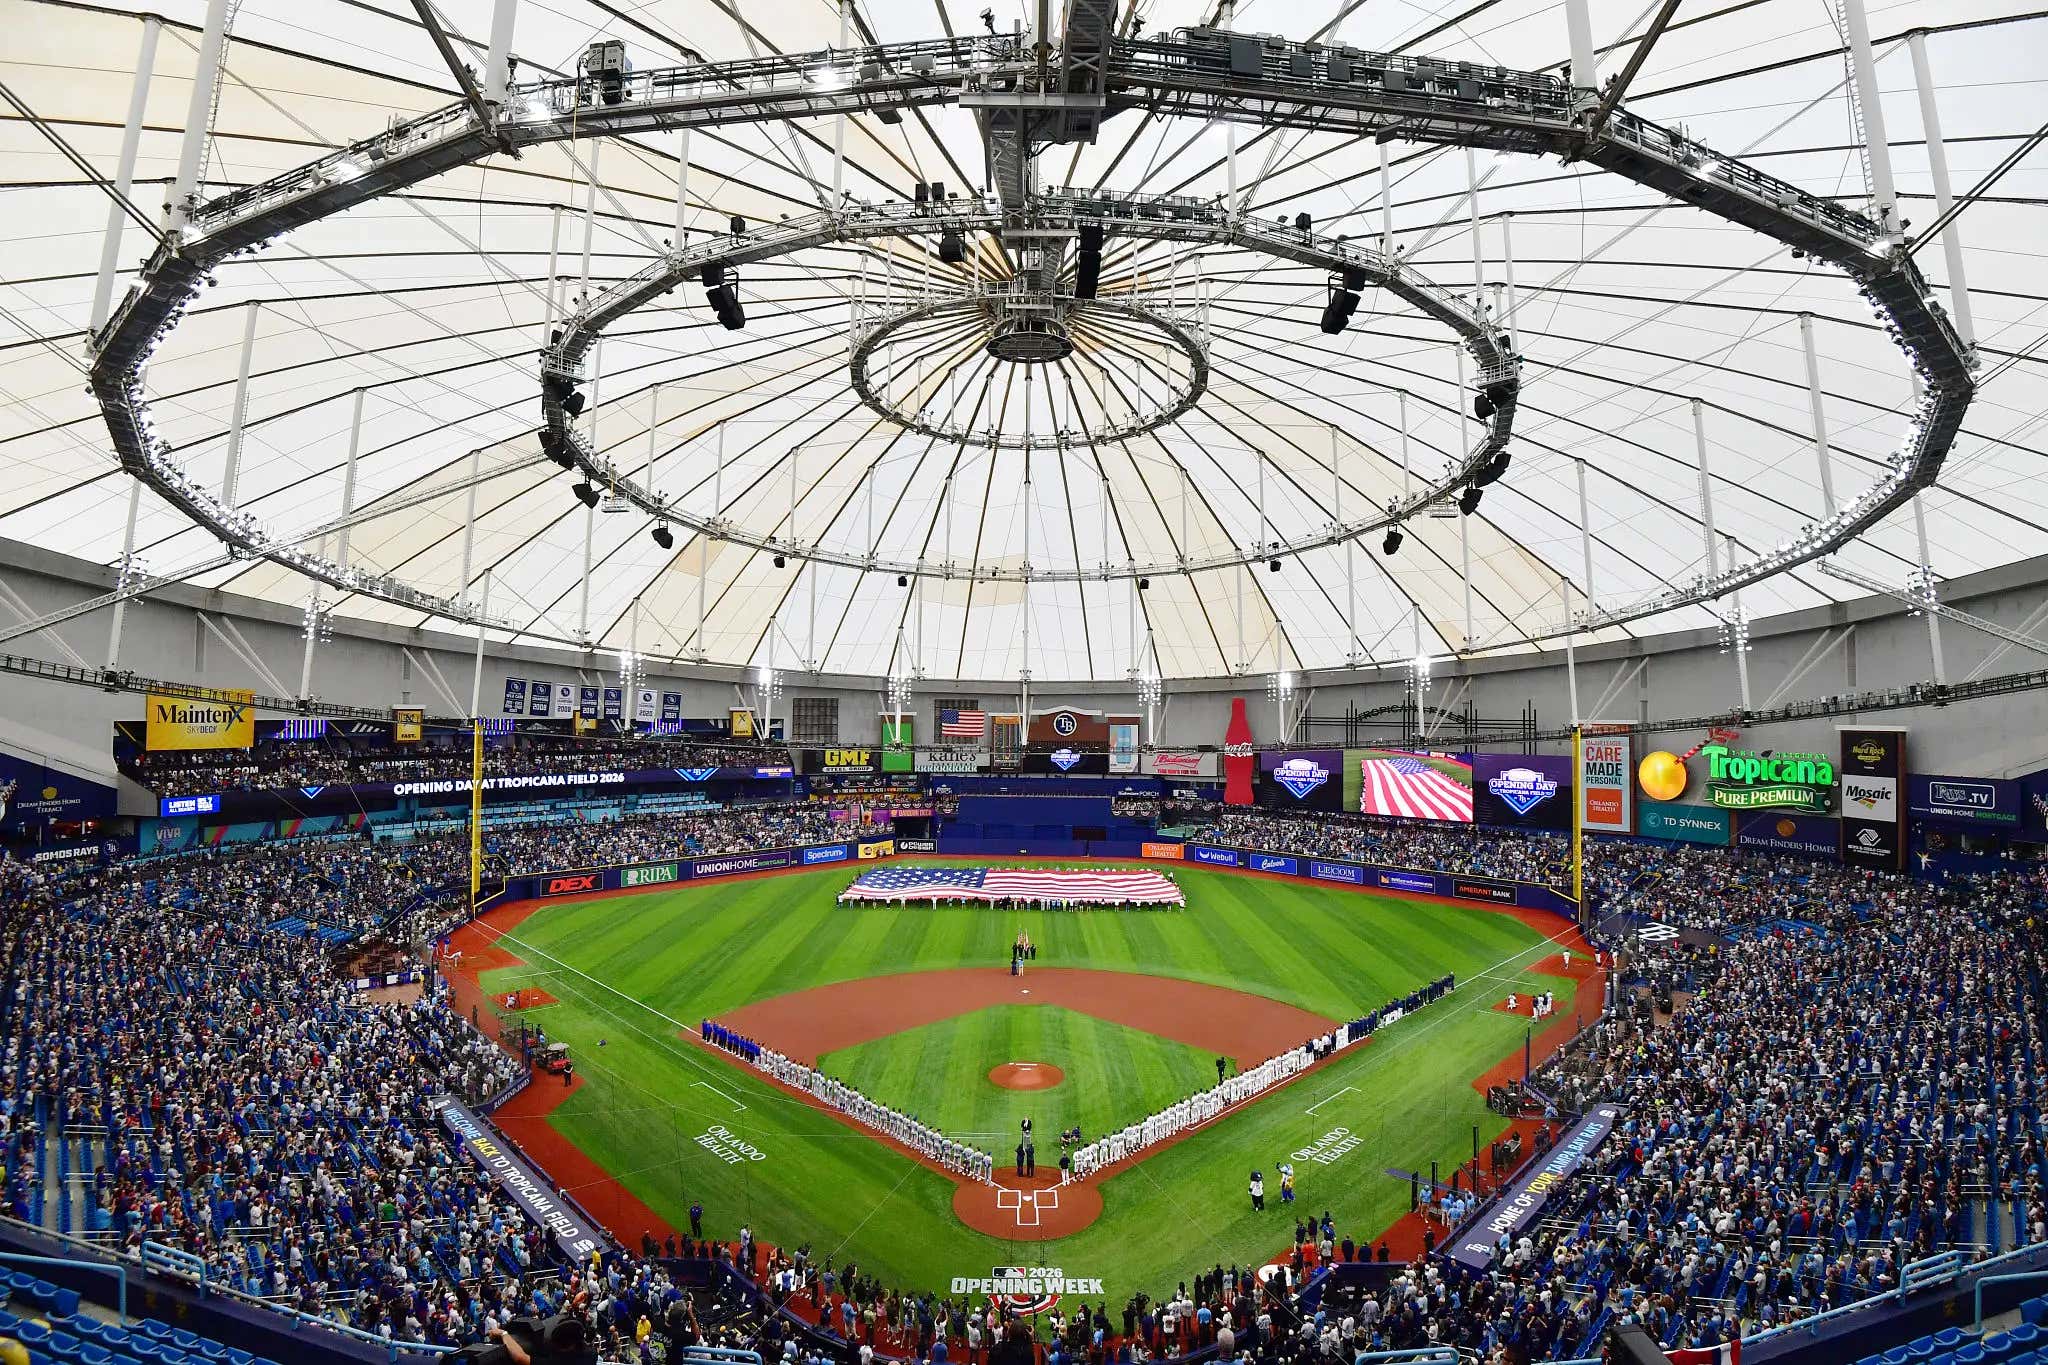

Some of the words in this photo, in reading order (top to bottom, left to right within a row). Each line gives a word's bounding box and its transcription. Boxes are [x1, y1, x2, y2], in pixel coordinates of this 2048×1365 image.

[156, 704, 247, 732] MaintenX
[1058, 718, 1073, 732] TB
[1586, 747, 1622, 762] CARE
[1586, 762, 1622, 776] MADE
[1702, 745, 1833, 786] Tropicana
[1275, 770, 1311, 778] OPENING
[1586, 777, 1623, 785] PERSONAL
[394, 782, 453, 795] OPENING
[481, 778, 498, 789] AT
[497, 775, 565, 788] TROPICANA
[567, 773, 598, 784] FIELD
[600, 772, 625, 783] 2026
[1491, 780, 1533, 790] OPENING
[1535, 782, 1555, 791] DAY
[1714, 789, 1748, 805] PURE
[1751, 787, 1814, 805] PREMIUM
[1846, 785, 1892, 800] Mosaic
[1930, 807, 1953, 817] UNION
[1953, 809, 1974, 818] HOME
[1975, 811, 2017, 822] MORTGAGE
[1664, 817, 1677, 826] TD
[1679, 818, 1721, 832] SYNNEX
[156, 827, 182, 841] VIVA
[1740, 835, 1768, 847] DREAM
[1770, 838, 1802, 851] FINDERS
[1805, 843, 1836, 854] HOMES
[34, 850, 73, 862] SOMOS
[73, 845, 100, 858] RAYS
[807, 849, 844, 862] Spectrum
[1151, 850, 1176, 858] HEALTH
[1210, 851, 1234, 863] Webull
[640, 866, 673, 884] RIPA
[1317, 866, 1356, 878] LECOM
[549, 875, 597, 893] DEX
[1492, 890, 1511, 898] BANK
[1583, 1122, 1604, 1143] RAYS
[694, 1133, 745, 1164] HEALTH
[708, 1125, 766, 1161] ORLANDO
[1291, 1127, 1350, 1161] ORLANDO
[1312, 1134, 1364, 1165] HEALTH
[1569, 1137, 1589, 1155] BAY
[1547, 1147, 1577, 1174] TAMPA
[443, 1107, 482, 1140] WELCOME
[471, 1137, 500, 1158] BACK
[490, 1156, 511, 1168] TO
[501, 1166, 553, 1214] TROPICANA
[544, 1211, 579, 1238] FIELD
[1525, 1172, 1557, 1194] YOUR
[1518, 1193, 1536, 1207] OF
[1487, 1206, 1525, 1234] HOME
[1029, 1268, 1063, 1278] 2026
[951, 1278, 1042, 1294] OPENING
[1044, 1279, 1105, 1294] WEEK
